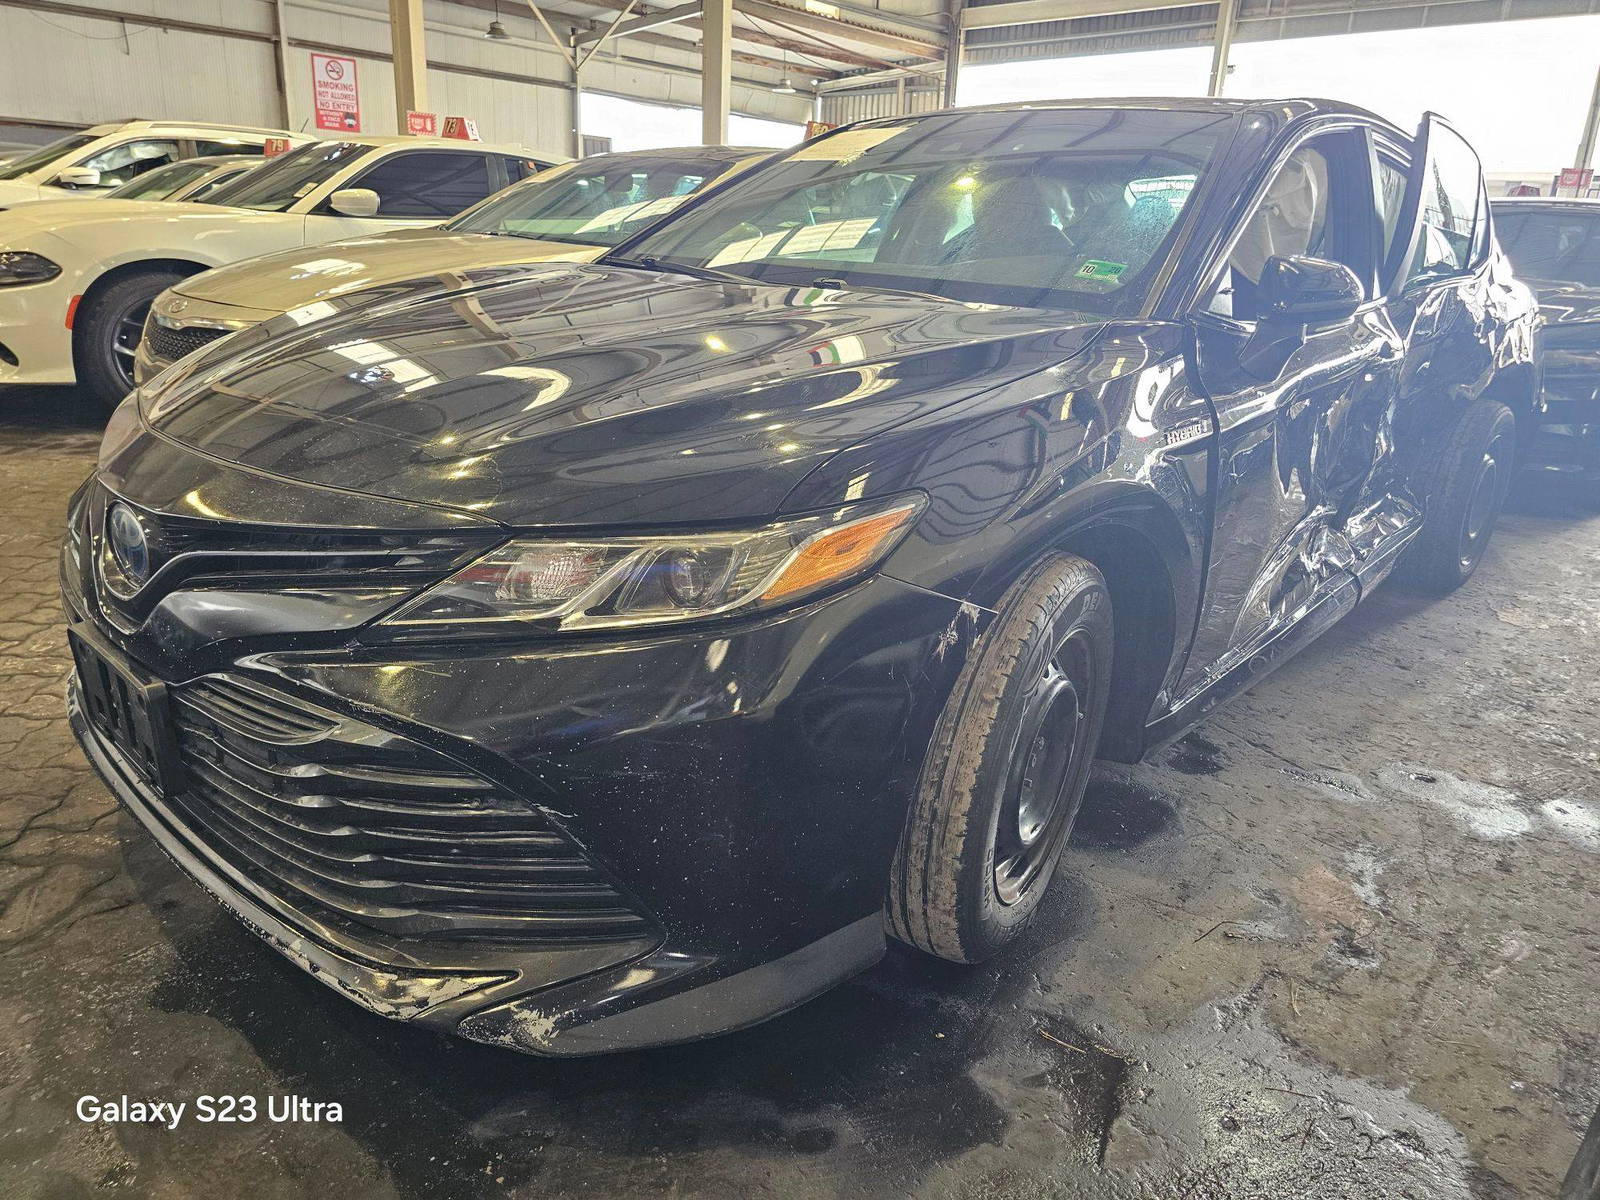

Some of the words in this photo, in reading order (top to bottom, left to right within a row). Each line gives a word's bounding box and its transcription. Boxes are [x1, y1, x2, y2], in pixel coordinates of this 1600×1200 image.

[317, 80, 354, 92] SMOKING
[320, 101, 330, 109] NO
[332, 102, 356, 112] ENTRY
[445, 118, 457, 134] 73
[271, 139, 284, 152] 79
[1082, 265, 1096, 274] 10
[1166, 423, 1202, 445] HYBRID
